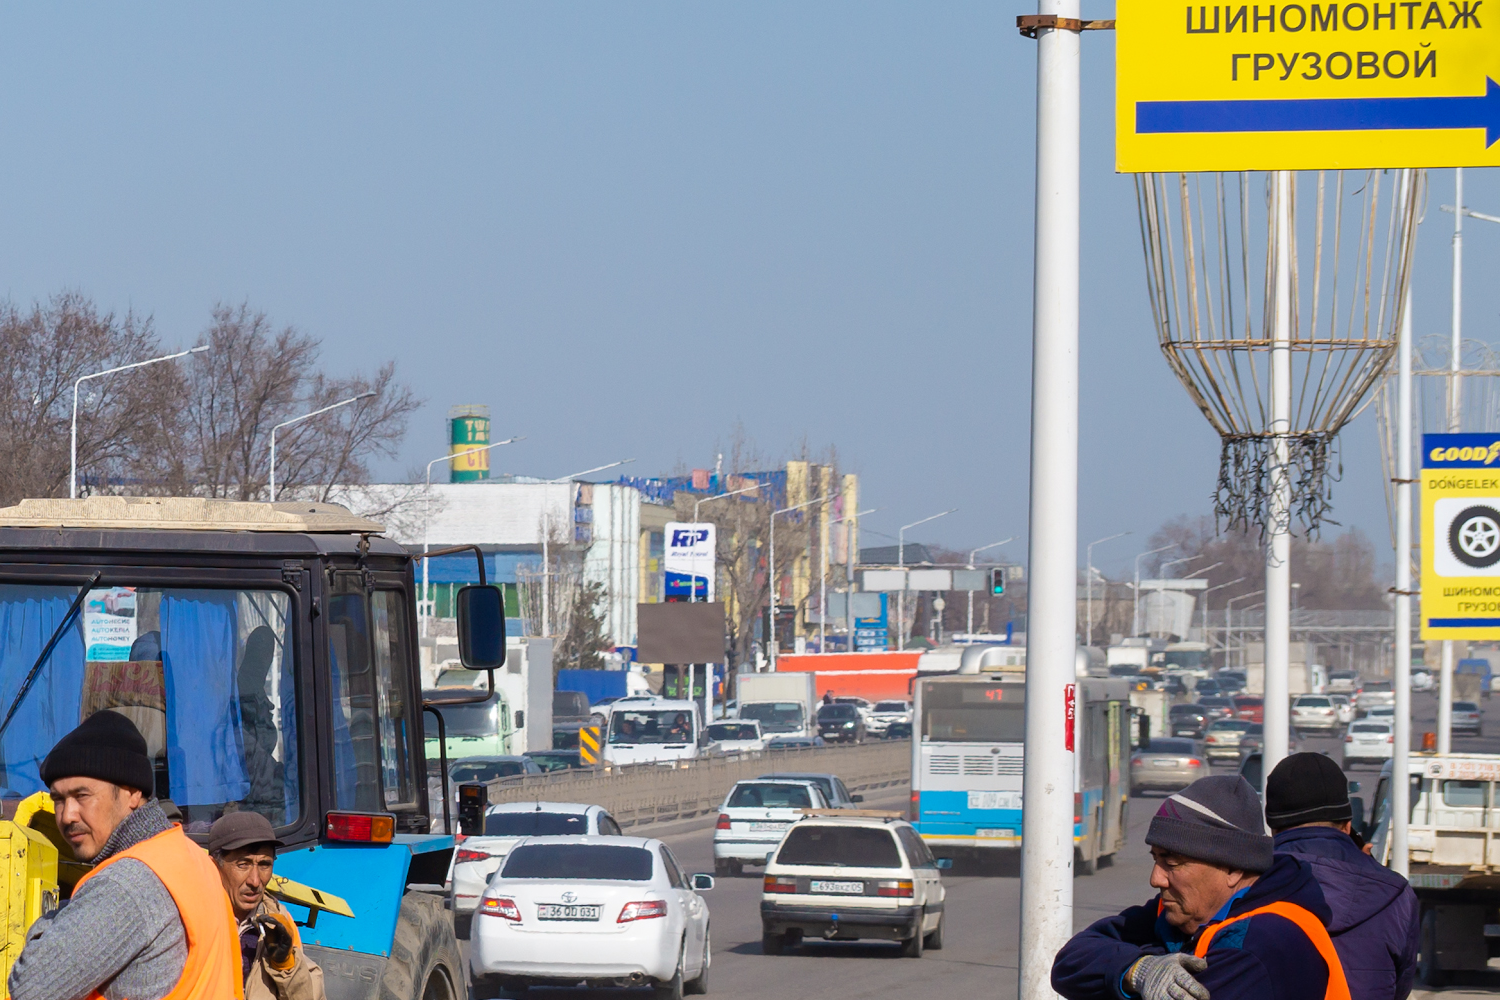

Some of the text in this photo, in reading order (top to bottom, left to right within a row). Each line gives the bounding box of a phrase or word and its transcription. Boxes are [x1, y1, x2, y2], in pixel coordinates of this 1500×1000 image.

[1186, 1, 1483, 34] ШИНОМОНТАЖ
[1231, 42, 1437, 81] ГРУЗОВОЙ
[1430, 445, 1498, 462] GOOD
[1443, 587, 1500, 597] ШИНОМО
[985, 689, 1003, 700] 47
